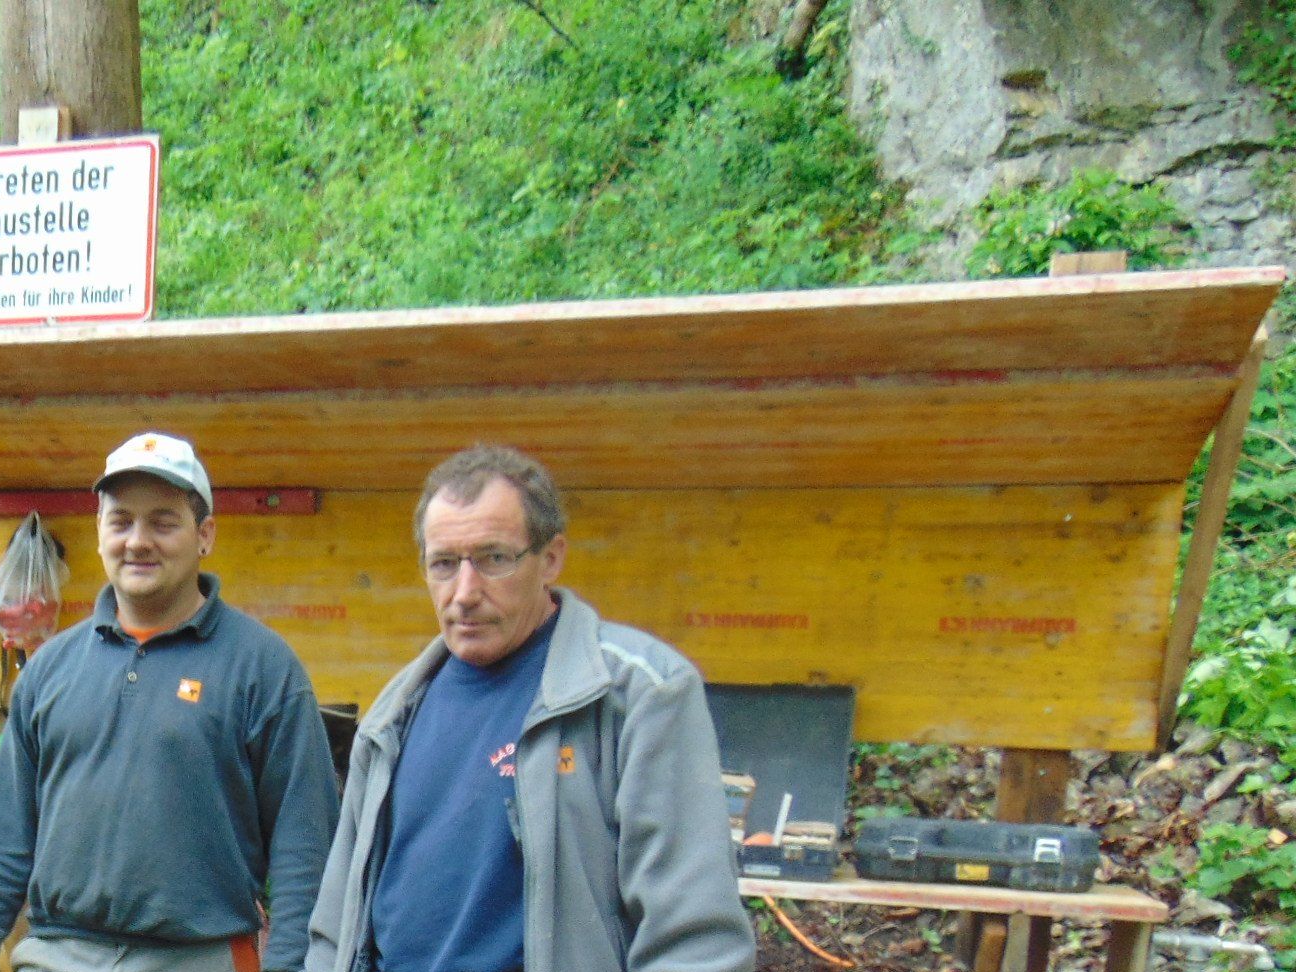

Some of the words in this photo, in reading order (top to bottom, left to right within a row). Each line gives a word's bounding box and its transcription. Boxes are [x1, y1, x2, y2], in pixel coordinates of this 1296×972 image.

[72, 159, 115, 192] der
[22, 289, 41, 307] für
[48, 287, 76, 306] ihre
[81, 284, 132, 304] Kinder!
